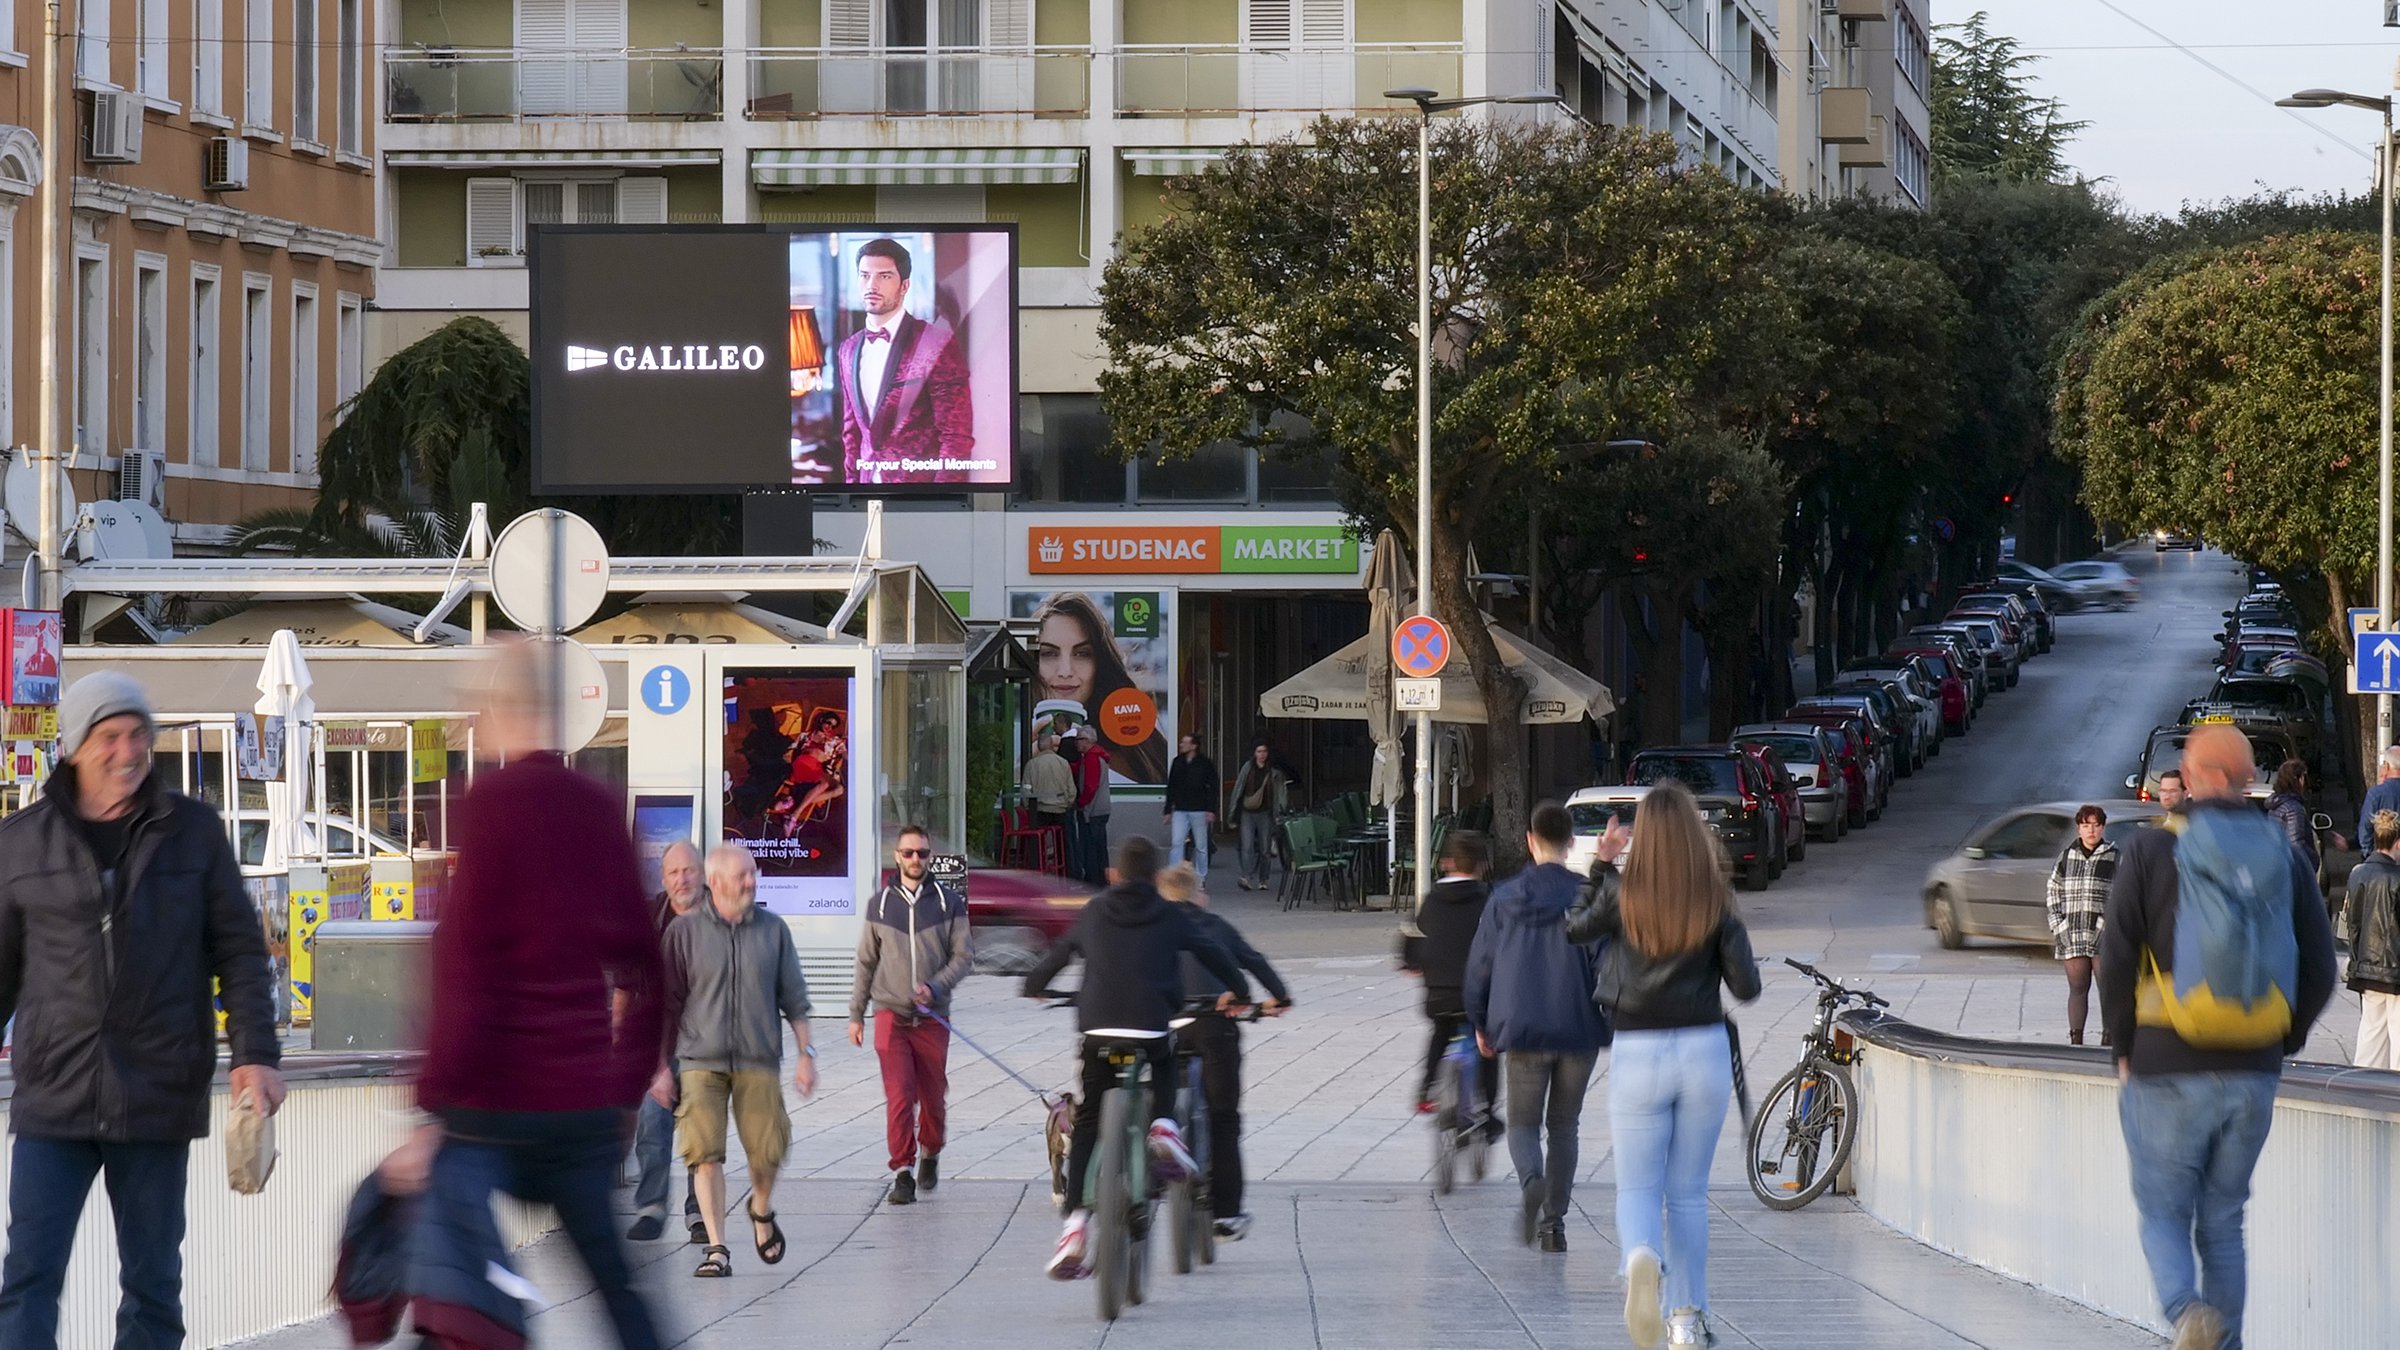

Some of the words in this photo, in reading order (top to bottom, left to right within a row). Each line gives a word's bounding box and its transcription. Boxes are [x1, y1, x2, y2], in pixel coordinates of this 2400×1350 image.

[613, 345, 765, 371] GALILEO
[856, 459, 874, 471] For
[876, 460, 900, 473] your
[901, 458, 943, 473] Special
[945, 458, 997, 471] Moments
[100, 513, 117, 528] vip
[1073, 539, 1207, 560] STUDENAC
[1233, 539, 1345, 560] MARKET
[1127, 602, 1141, 611] TO
[1132, 612, 1149, 622] GO
[1114, 704, 1141, 715] KAVA
[1321, 701, 1342, 709] ZADAR
[327, 727, 366, 746] EXCURSIONS
[730, 838, 778, 847] Ultimativni
[779, 838, 801, 847] chill.
[770, 849, 787, 859] tvoj
[788, 848, 809, 858] vibe
[942, 857, 959, 867] CAR
[808, 898, 849, 908] zalando
